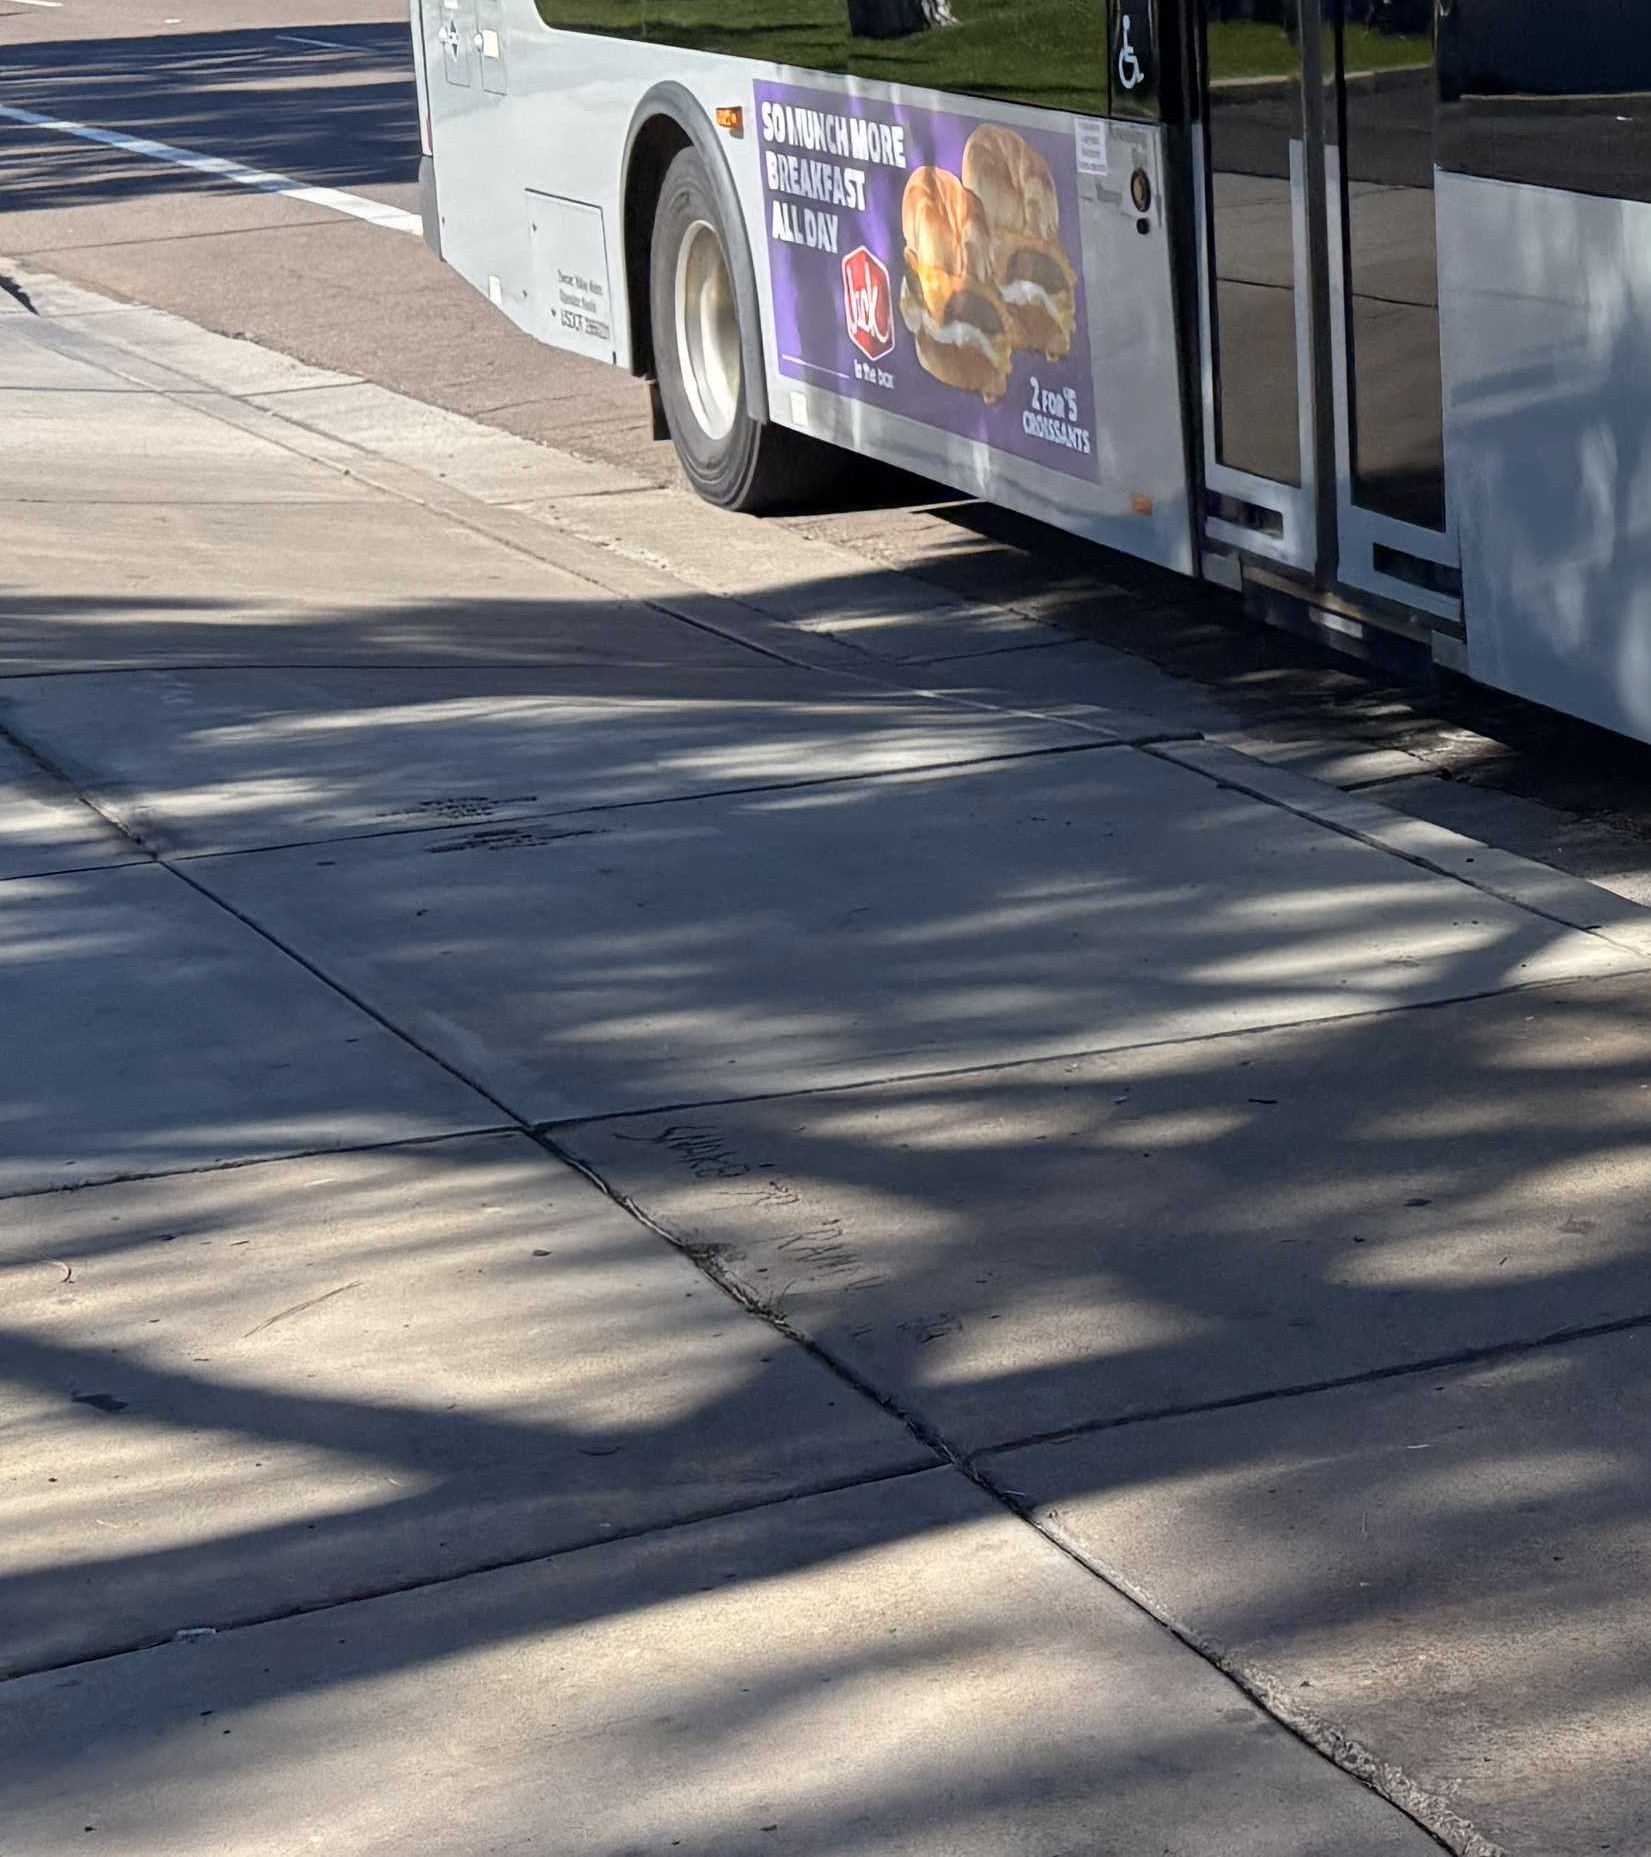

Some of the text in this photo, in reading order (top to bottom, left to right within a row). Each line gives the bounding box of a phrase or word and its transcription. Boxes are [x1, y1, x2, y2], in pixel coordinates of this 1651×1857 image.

[761, 101, 907, 169] SO MUNCH MORE
[765, 150, 866, 212] BREAKFAST
[772, 200, 838, 254] ALL DAY
[846, 261, 890, 344] Jack
[1030, 376, 1040, 411] 2
[1041, 390, 1065, 418] FOR
[1022, 410, 1091, 454] CROISSANTS
